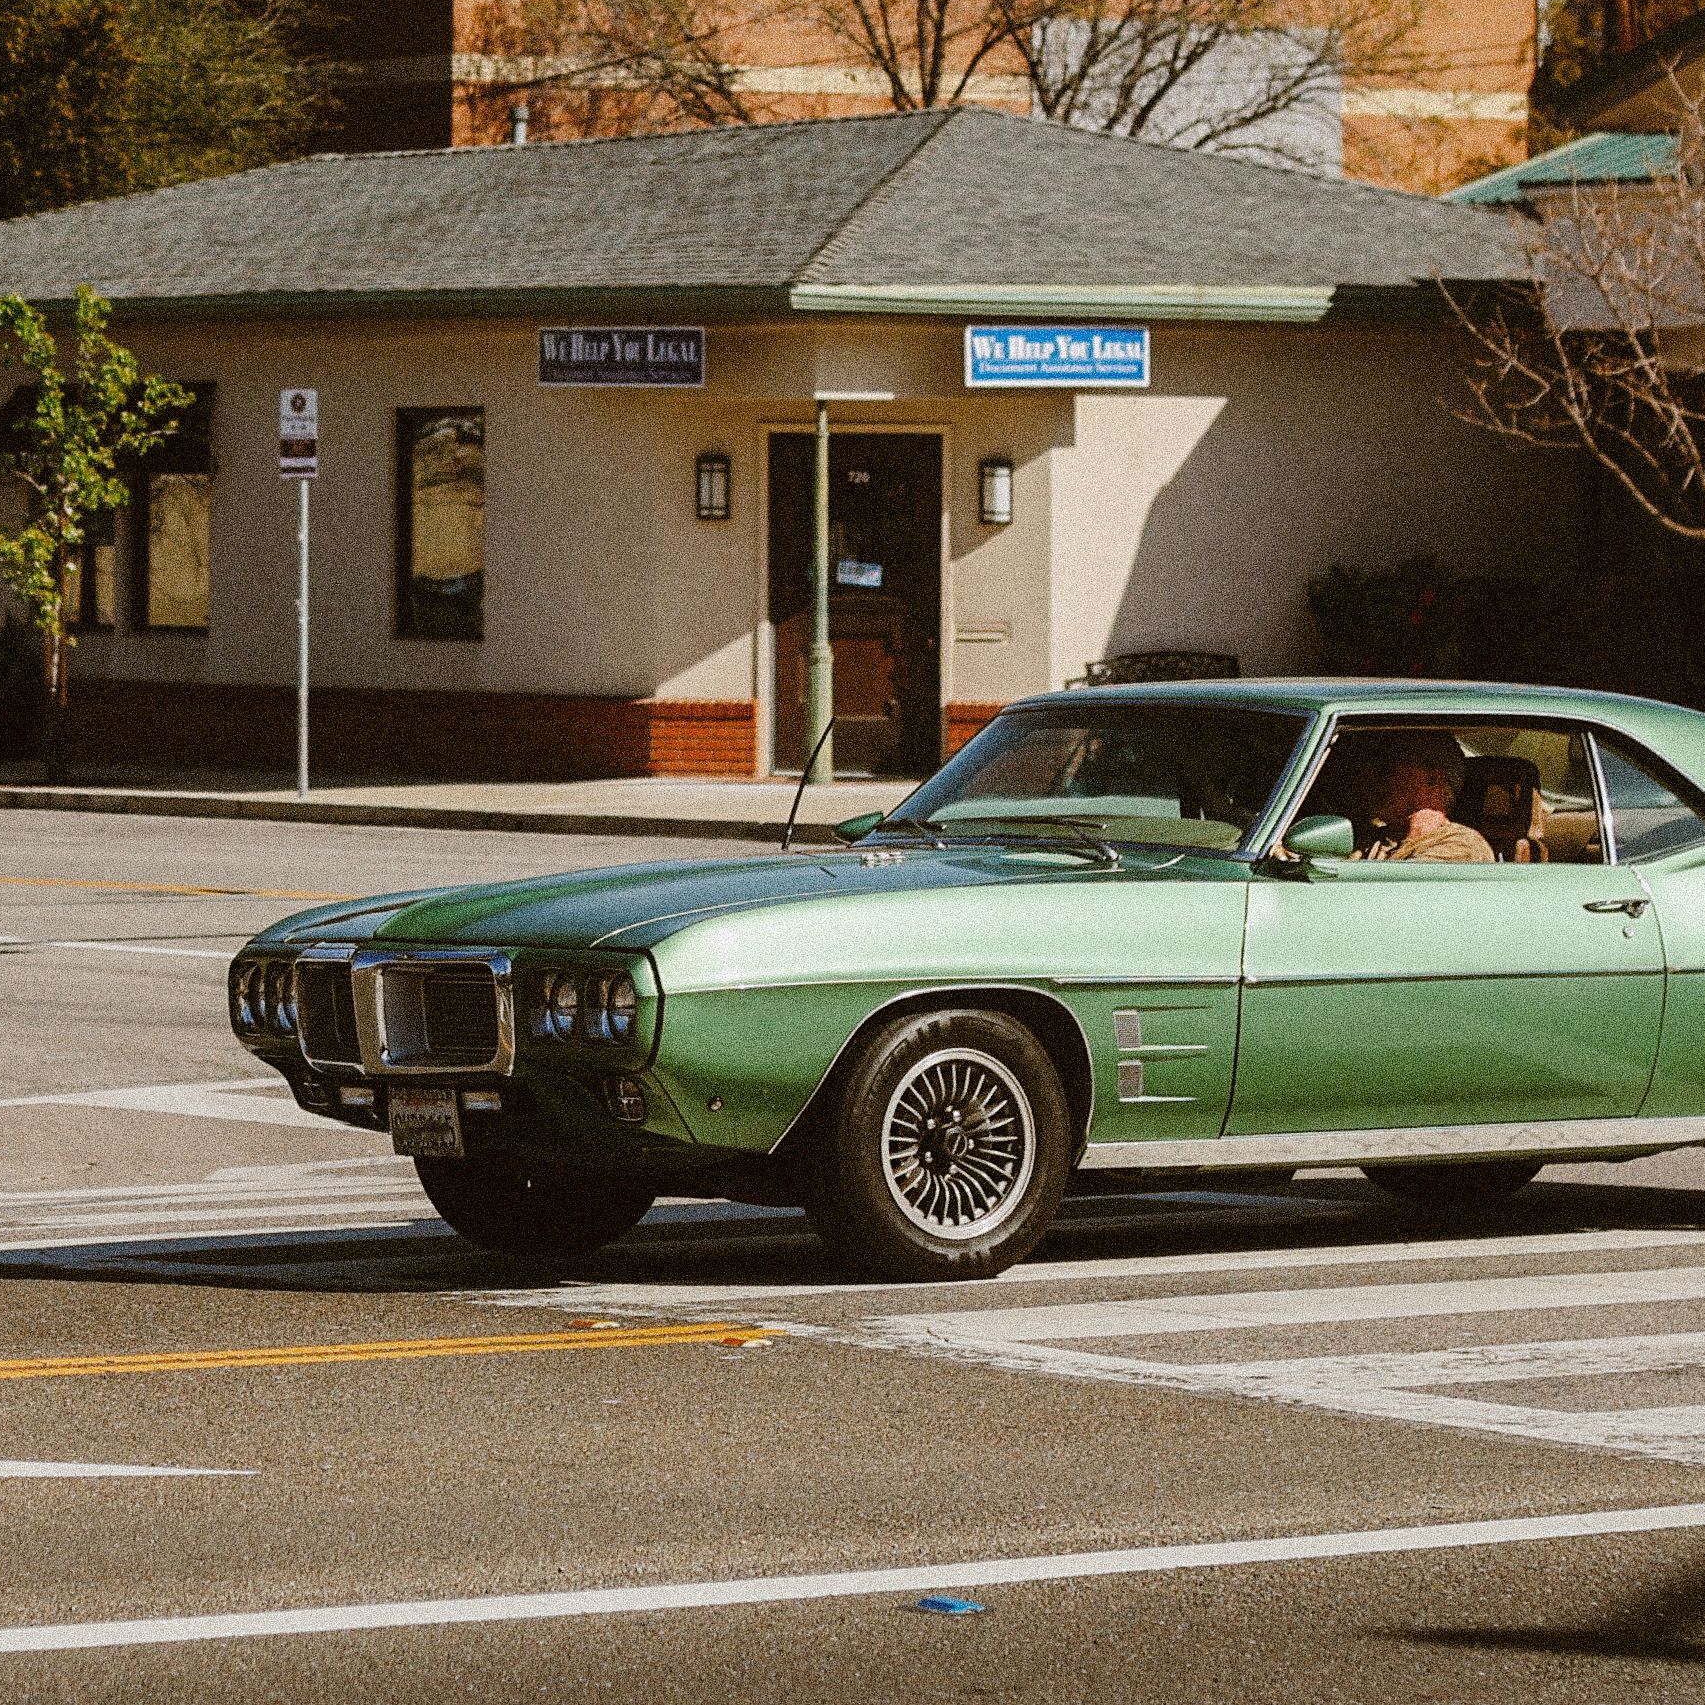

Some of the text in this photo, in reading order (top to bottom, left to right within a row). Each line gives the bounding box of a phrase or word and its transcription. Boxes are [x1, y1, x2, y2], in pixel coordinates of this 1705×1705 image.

[570, 334, 609, 361] HELP
[973, 335, 1004, 360] WE
[1007, 335, 1055, 360] HELP
